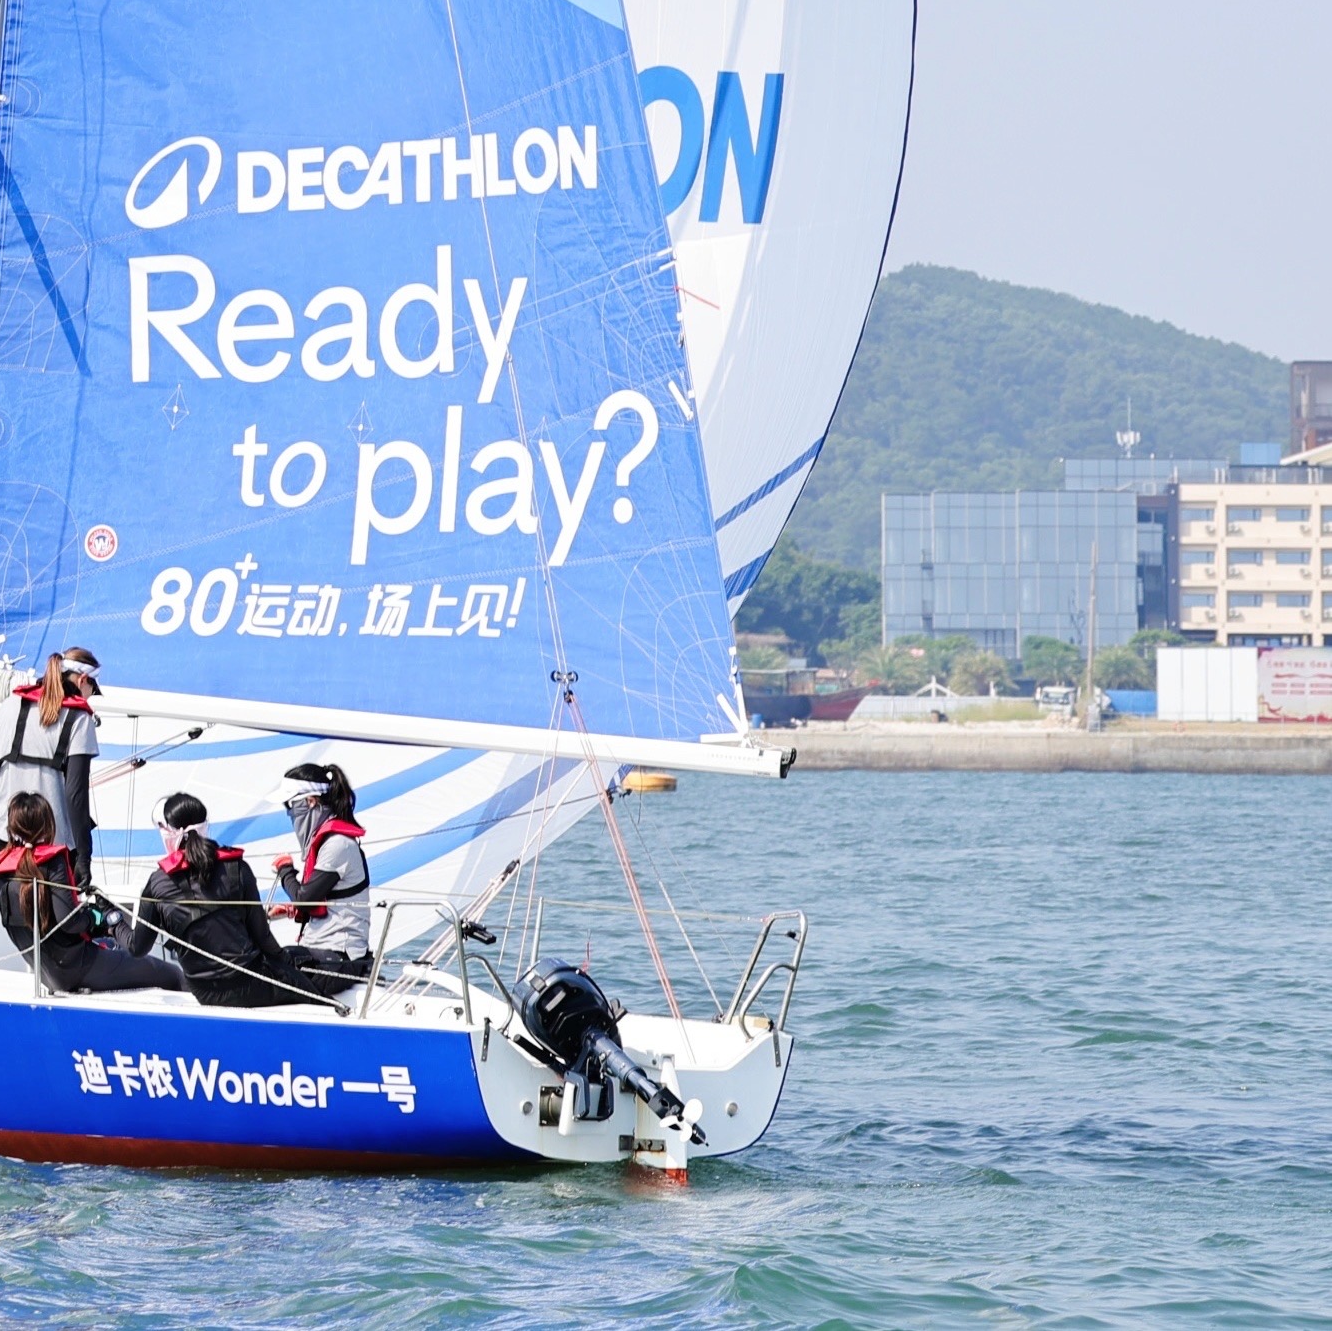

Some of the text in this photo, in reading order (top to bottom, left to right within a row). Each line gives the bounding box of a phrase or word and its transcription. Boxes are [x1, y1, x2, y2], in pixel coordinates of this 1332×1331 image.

[237, 125, 598, 214] DECATHLON
[128, 244, 528, 405] Ready
[232, 390, 660, 567] to play?
